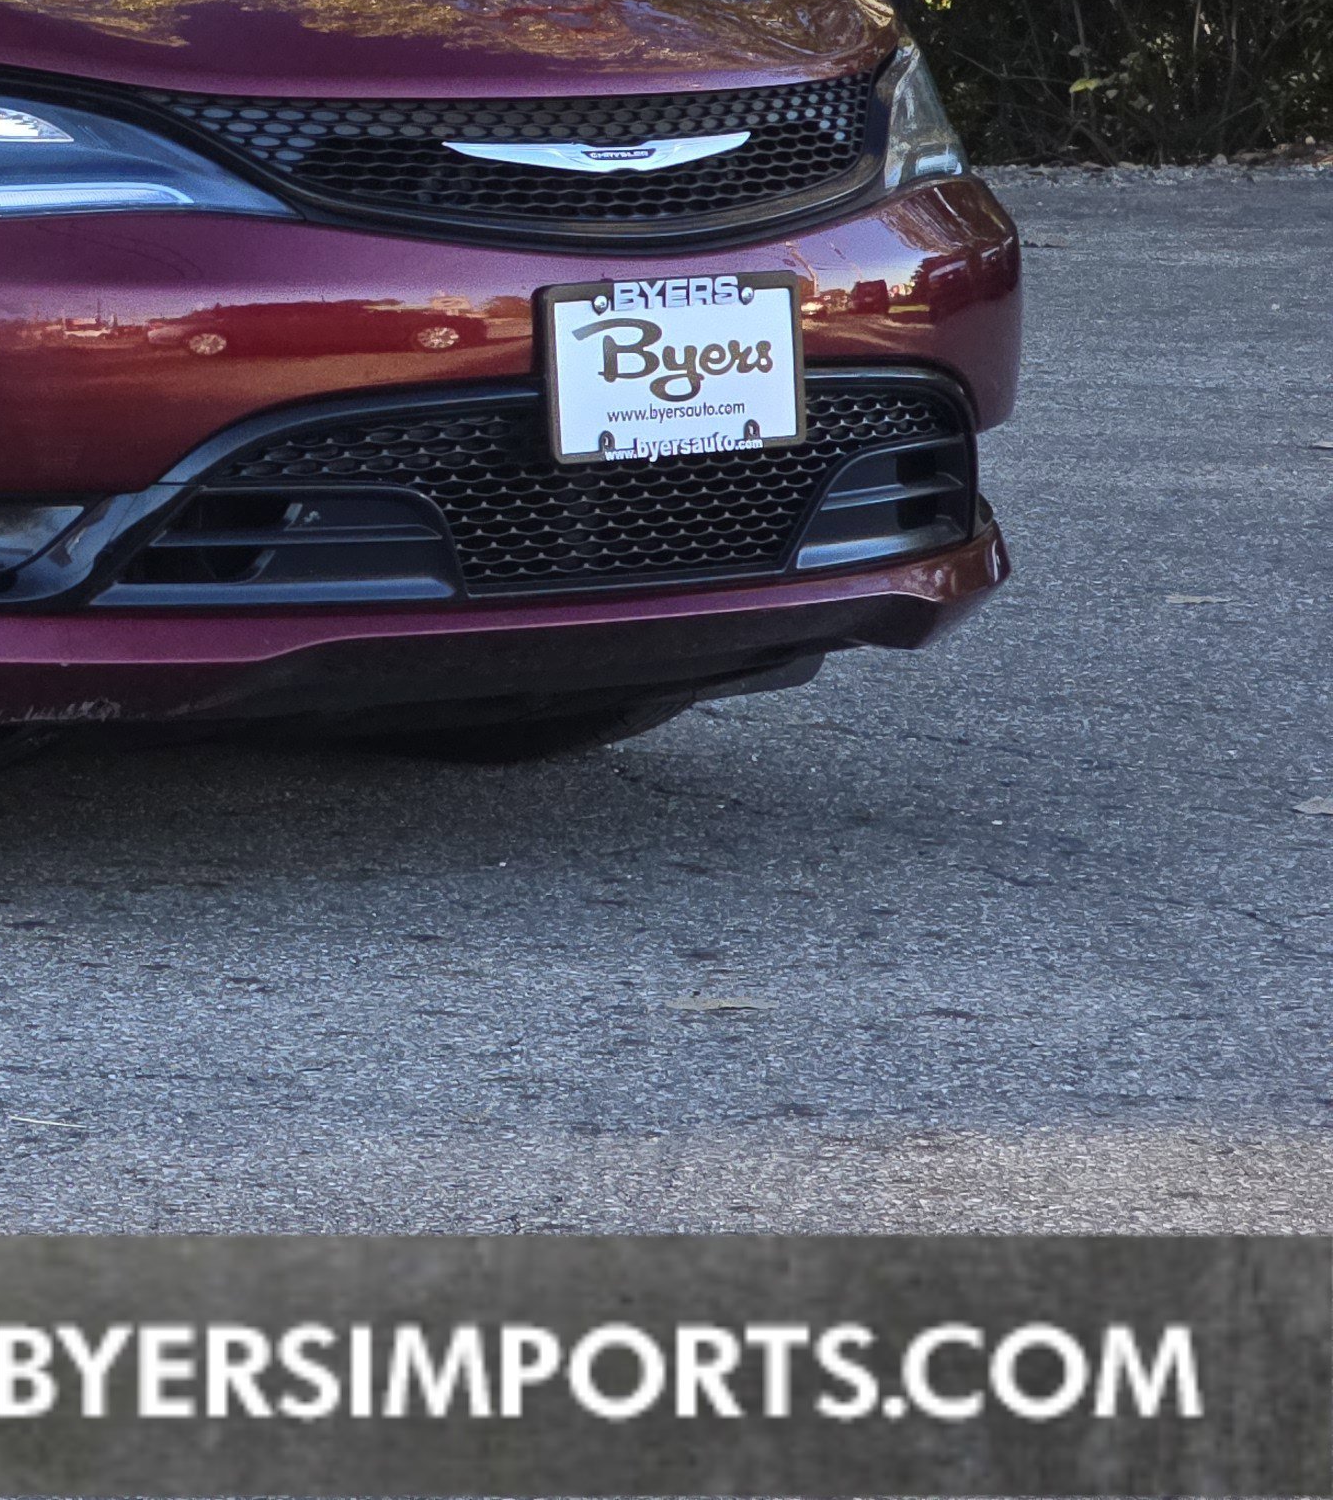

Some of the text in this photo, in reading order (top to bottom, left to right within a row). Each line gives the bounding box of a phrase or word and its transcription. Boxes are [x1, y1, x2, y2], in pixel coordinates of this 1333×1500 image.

[611, 275, 740, 312] BYERS
[572, 317, 774, 402] Byers
[607, 401, 746, 424] www.byersauto.com
